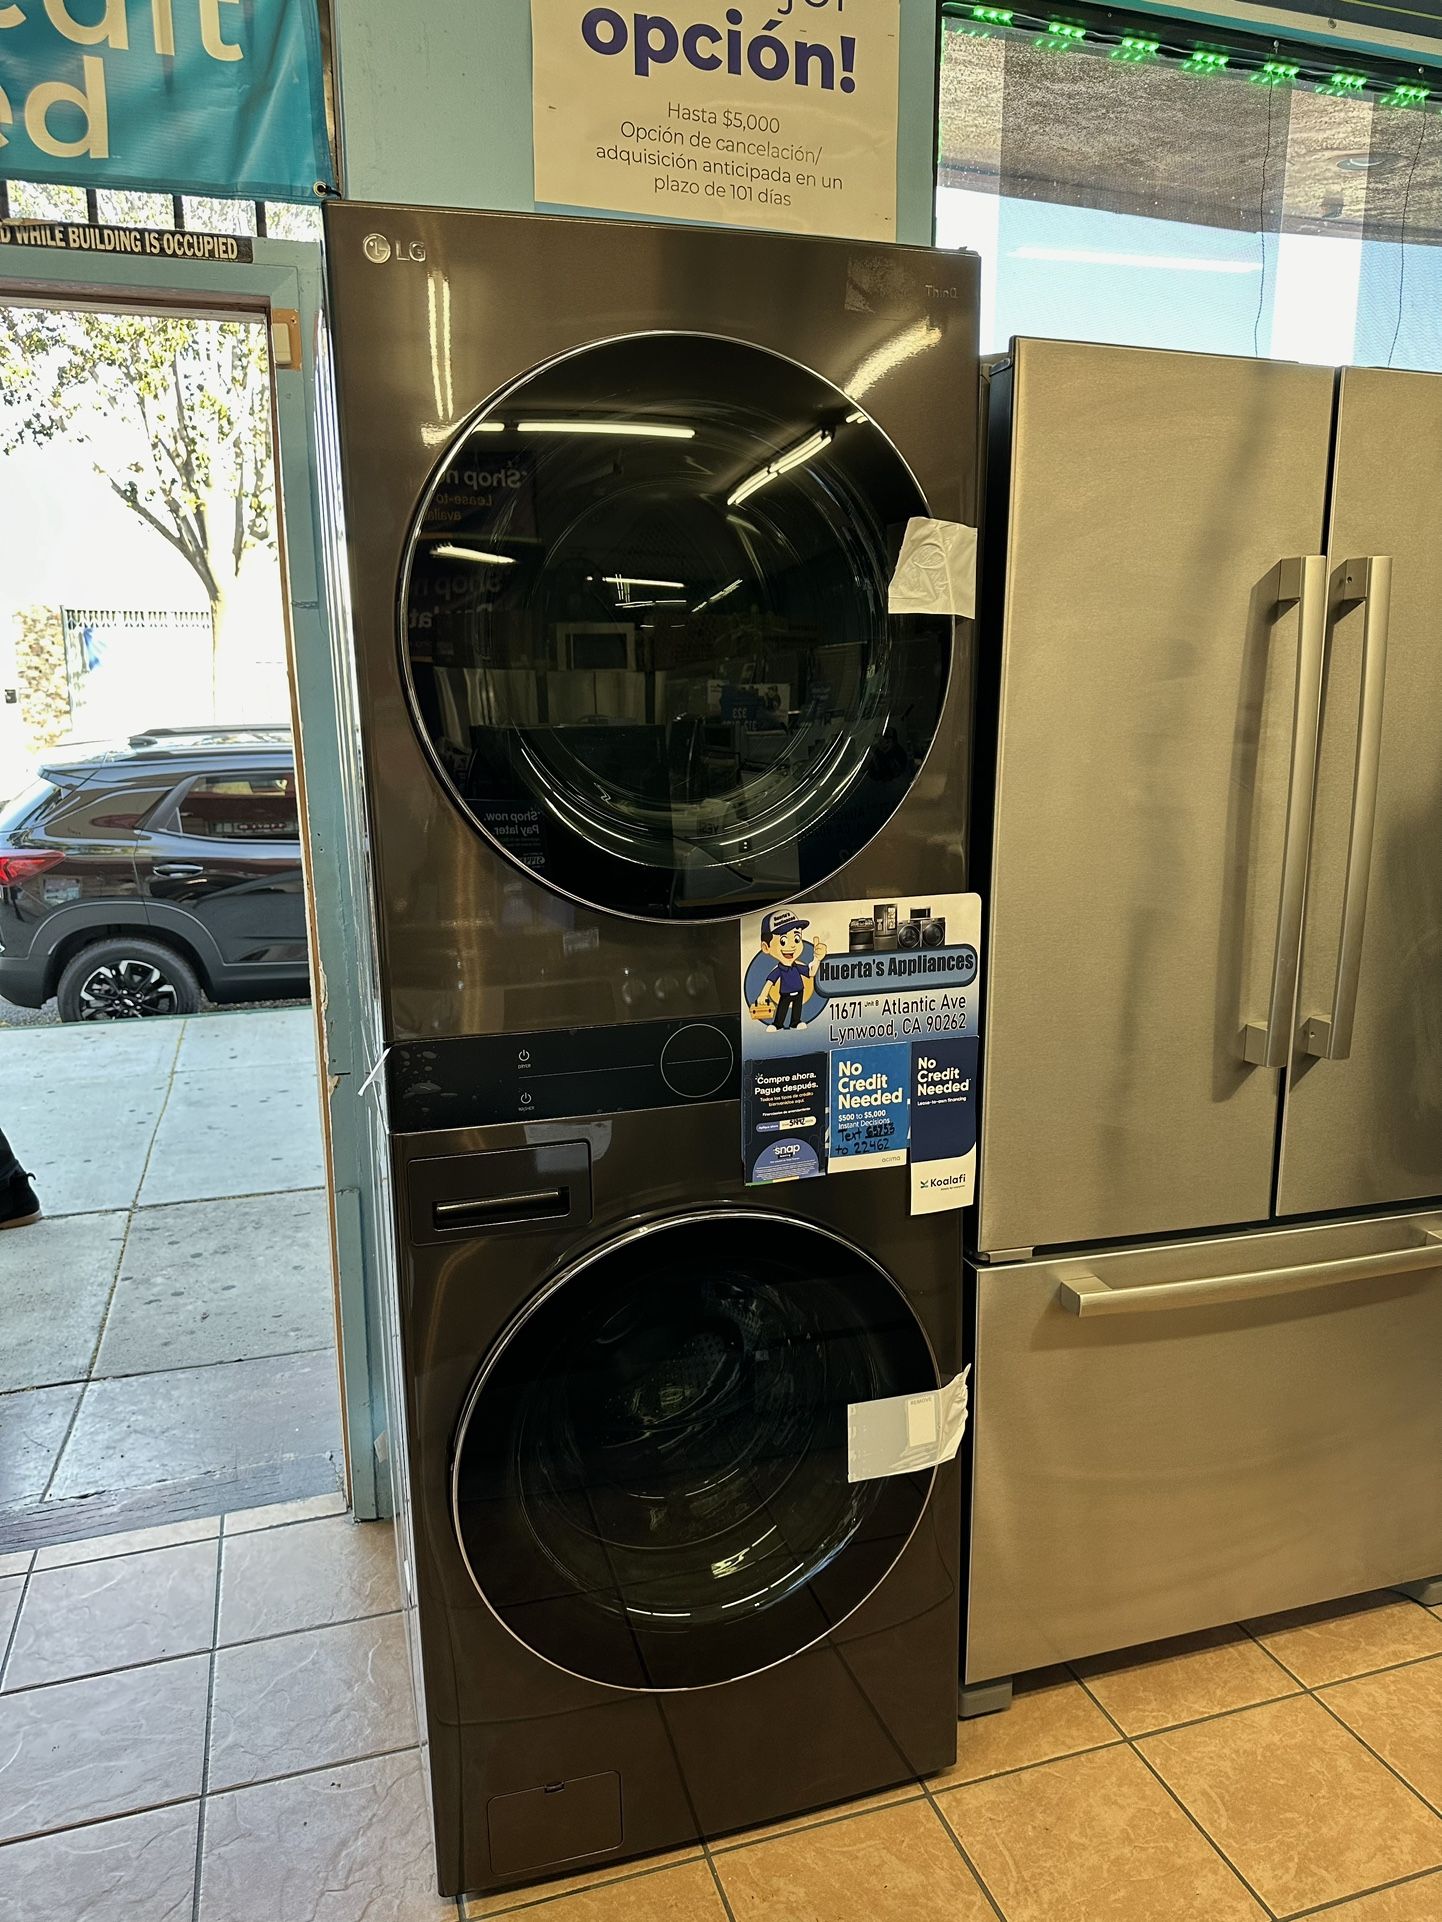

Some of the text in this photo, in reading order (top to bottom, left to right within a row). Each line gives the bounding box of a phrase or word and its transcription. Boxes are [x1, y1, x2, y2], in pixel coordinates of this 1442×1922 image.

[581, 7, 857, 94] opción!
[667, 101, 781, 135] Hasta $5,000
[620, 120, 824, 166] Opción de cancelación/
[596, 144, 843, 191] adquisición anticipada en un
[654, 174, 792, 207] plazo de 101 días
[15, 225, 66, 247] WHILE
[69, 227, 142, 253] BUILDING
[145, 231, 160, 253] IS
[163, 233, 238, 260] OCCUPIED
[396, 240, 426, 262] LG
[925, 284, 958, 299] ThinQ
[820, 953, 974, 981] Huerta's Appliances
[829, 1002, 863, 1021] 11671
[881, 996, 936, 1016] Atlantic
[940, 994, 966, 1010] Ave
[829, 1012, 966, 1045] Lynwood, CA 90262
[838, 1061, 863, 1077] No
[918, 1057, 936, 1070] No
[757, 1072, 817, 1084] Compre ahora.
[838, 1073, 888, 1093] Credit
[917, 1067, 960, 1083] Credit
[755, 1081, 819, 1096] Pague después.
[917, 1079, 970, 1096] Needed
[838, 1087, 903, 1110] Needed
[838, 1114, 855, 1122] $500
[864, 1109, 886, 1119] $5,000
[838, 1118, 890, 1130] Instant Decisions
[838, 1127, 862, 1142] Text
[774, 1144, 800, 1155] snap
[835, 1138, 891, 1155] to 22462
[930, 1173, 966, 1187] Koalafi
